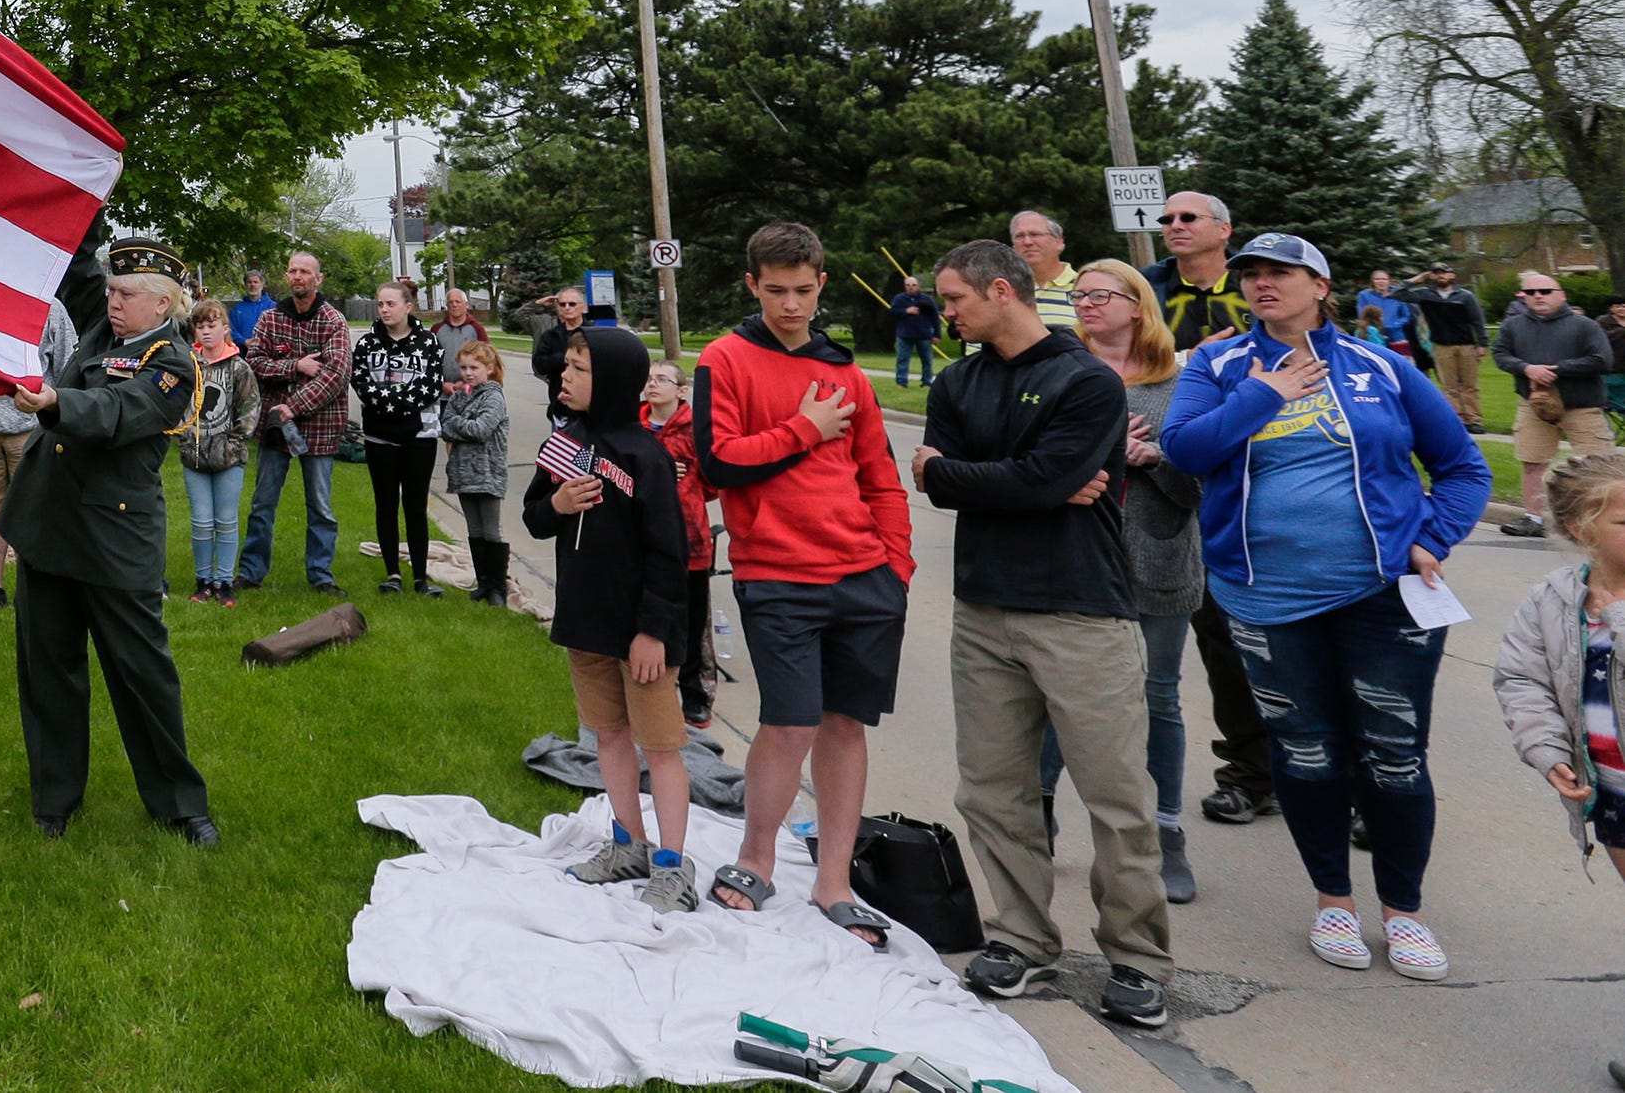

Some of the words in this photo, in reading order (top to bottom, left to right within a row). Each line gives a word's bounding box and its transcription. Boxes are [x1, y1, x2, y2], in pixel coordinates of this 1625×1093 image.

[1111, 173, 1158, 185] TRUCK
[1114, 188, 1160, 200] ROUTE
[370, 352, 425, 374] USA
